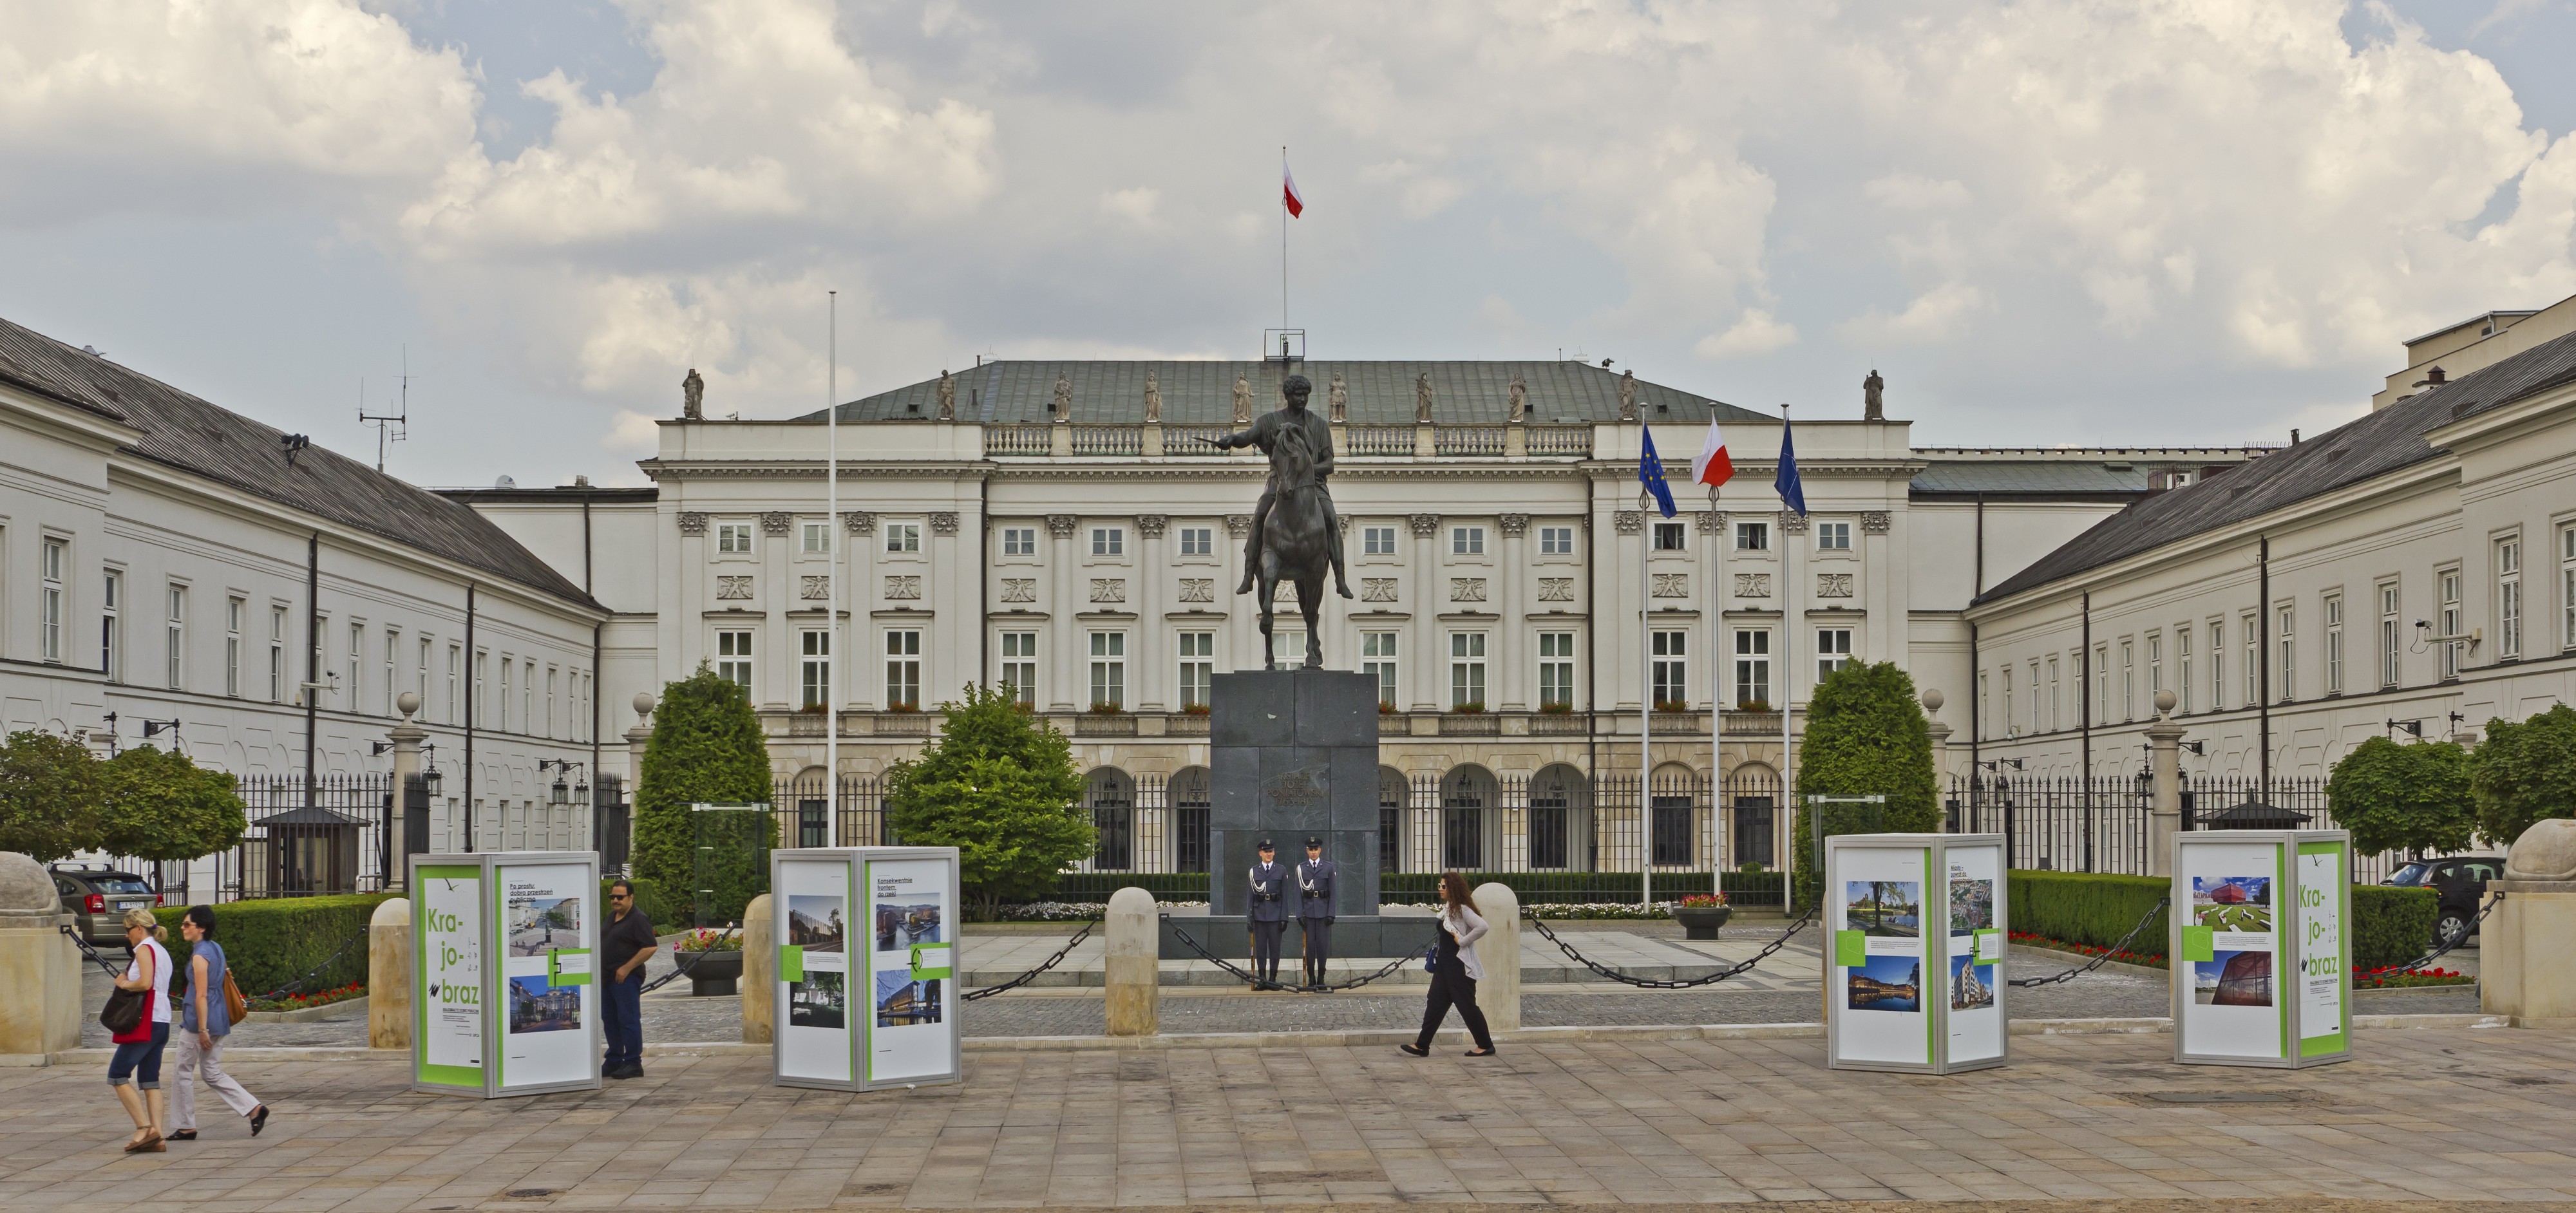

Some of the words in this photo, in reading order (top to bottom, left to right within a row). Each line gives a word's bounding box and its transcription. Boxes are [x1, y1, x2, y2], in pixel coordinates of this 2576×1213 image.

[1266, 789, 1324, 798] PONIATOWSKI
[2299, 885, 2325, 908] Kra-
[428, 908, 463, 932] Kra-
[2308, 916, 2325, 946] jo-
[440, 941, 464, 972] jo-
[2309, 953, 2338, 976] braz
[442, 979, 479, 1004] braz
